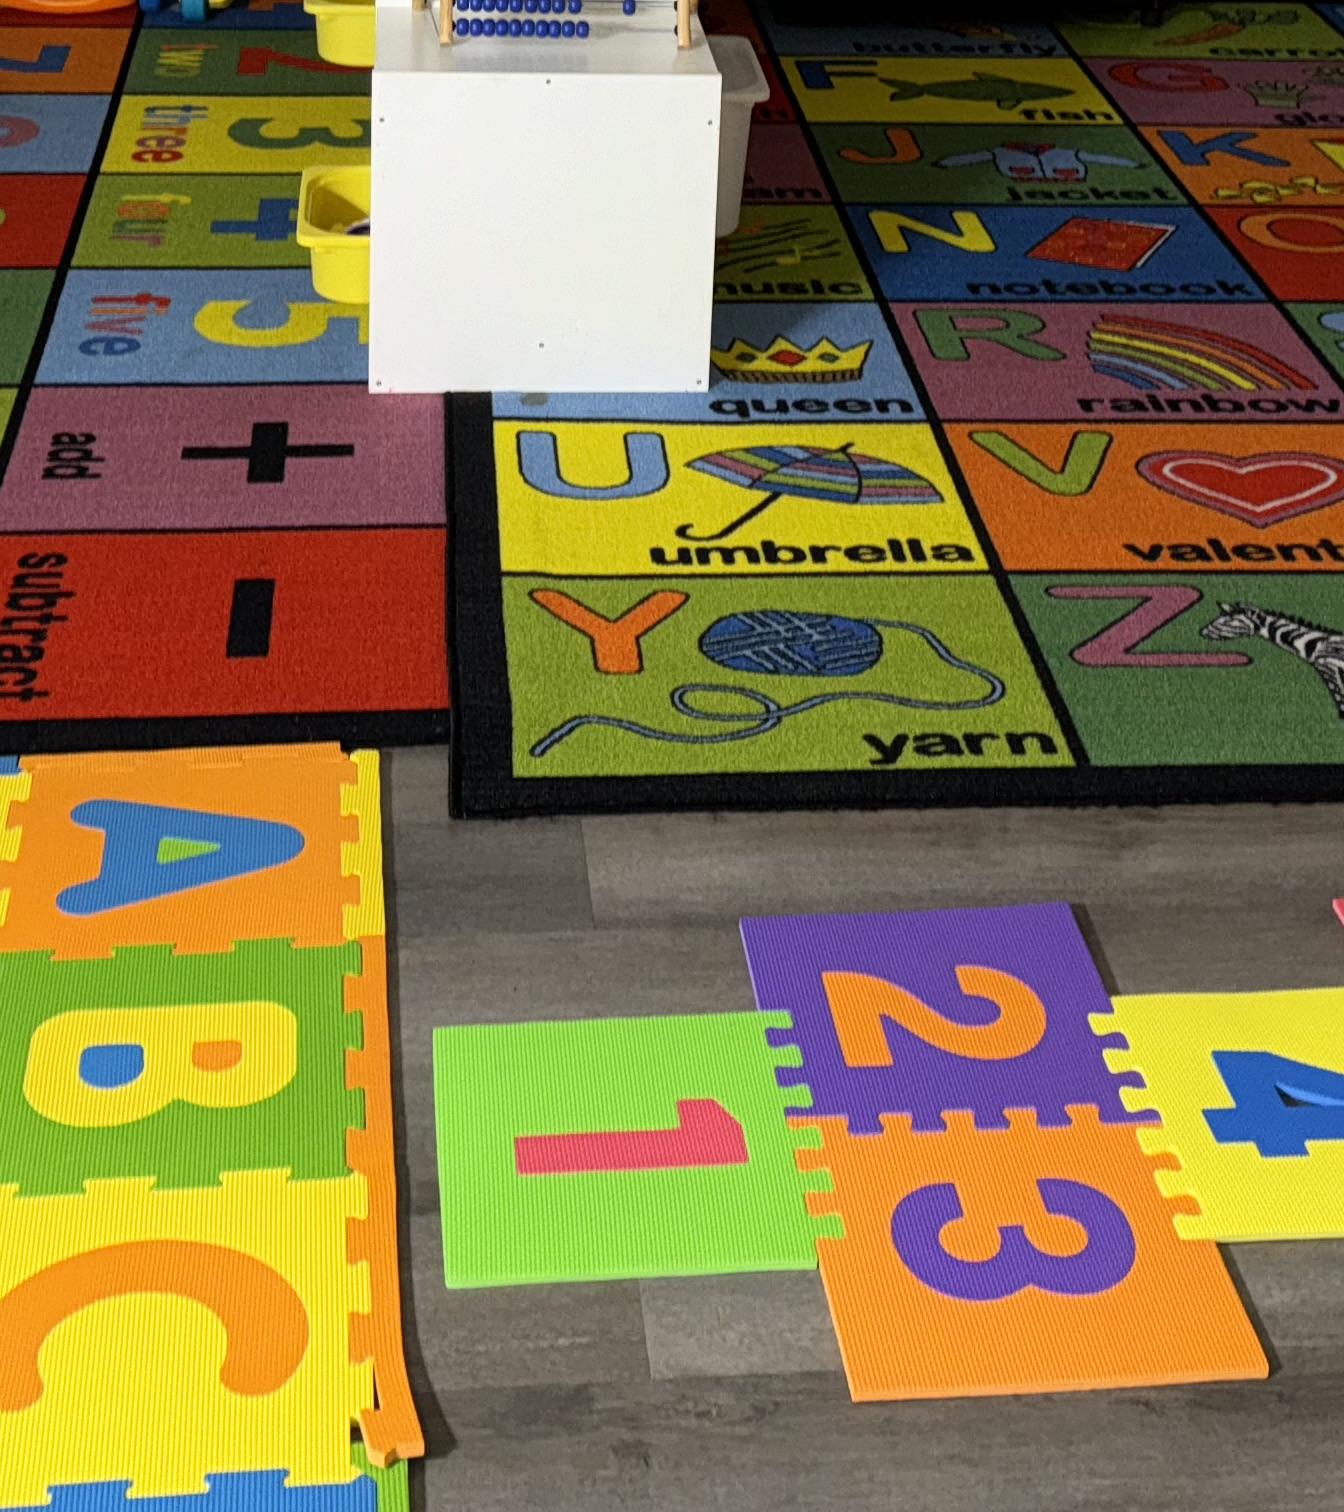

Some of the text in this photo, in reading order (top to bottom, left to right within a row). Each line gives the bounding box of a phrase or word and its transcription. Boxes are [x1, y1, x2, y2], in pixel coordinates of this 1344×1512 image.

[131, 104, 209, 164] three
[1020, 107, 1116, 122] fish
[109, 192, 192, 248] four
[1006, 187, 1184, 204] jacket
[965, 278, 1257, 299] notebook
[78, 292, 172, 356] five
[708, 395, 916, 420] queen
[1077, 390, 1343, 416] rainbow
[41, 432, 106, 480] add
[515, 430, 670, 500] U
[968, 429, 1114, 497] V
[648, 538, 976, 571] umbrella
[528, 589, 690, 676] Y
[1046, 583, 1254, 669] Z
[861, 727, 1059, 767] yarn
[55, 798, 306, 918] A
[821, 964, 1048, 1068] 2
[23, 999, 299, 1128] B
[513, 1098, 750, 1176] 1
[889, 1177, 1137, 1304] 3
